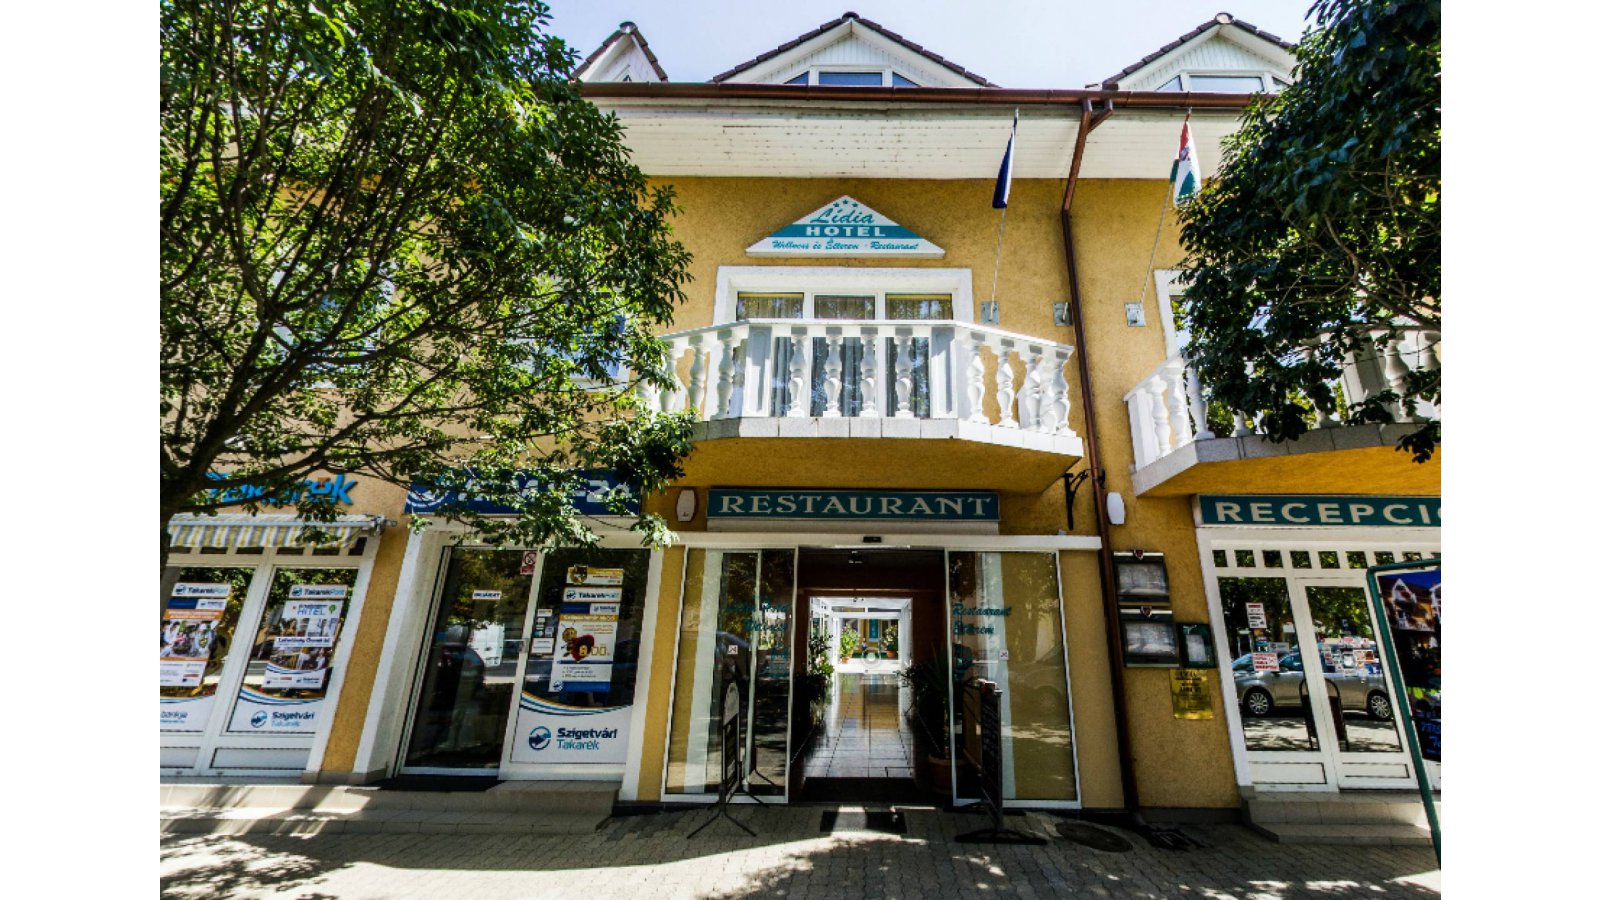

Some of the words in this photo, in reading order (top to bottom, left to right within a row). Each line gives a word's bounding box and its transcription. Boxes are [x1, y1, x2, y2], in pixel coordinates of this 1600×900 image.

[805, 226, 886, 237] HOTEL
[717, 494, 992, 516] RESTAURANT
[1214, 501, 1441, 525] RECEPCI
[557, 727, 618, 740] Szigetvári
[556, 738, 600, 750] Takarék
